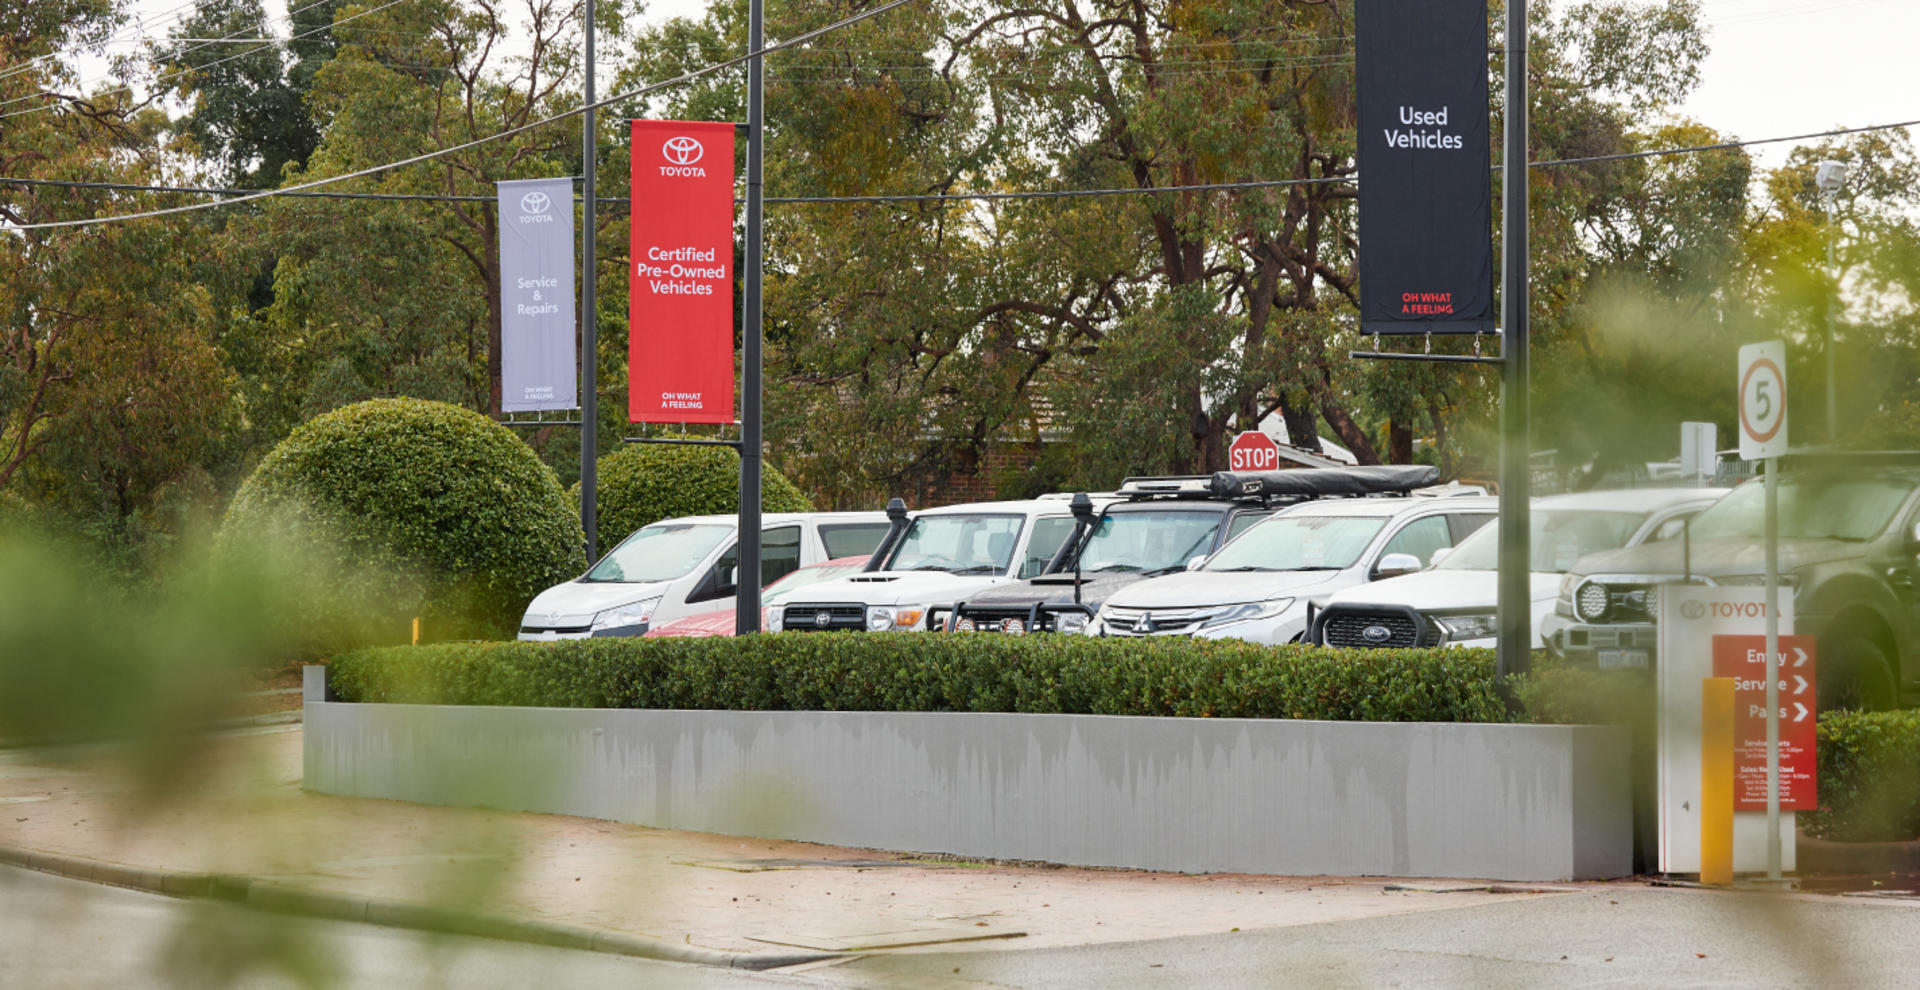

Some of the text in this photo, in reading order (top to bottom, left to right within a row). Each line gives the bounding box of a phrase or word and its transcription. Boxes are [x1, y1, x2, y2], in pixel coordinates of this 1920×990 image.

[1399, 105, 1448, 125] Used
[1383, 128, 1463, 149] Vehicles
[659, 166, 706, 177] TOYOTA
[519, 214, 552, 224] TOYOTA
[648, 246, 715, 262] Certified
[637, 263, 725, 279] Pre-Owned
[517, 275, 558, 290] Service
[649, 279, 713, 295] Vehicles
[532, 289, 543, 302] &
[1402, 292, 1452, 303] OH WHAT
[517, 302, 560, 318] Repairs
[1401, 304, 1454, 315] A FEELING
[662, 392, 703, 401] OH WHAT
[1756, 380, 1771, 421] 5
[661, 400, 703, 409] A FEELING
[1233, 447, 1276, 468] STOP
[1708, 602, 1782, 618] TOYOT
[1746, 648, 1788, 667] Eny
[1734, 676, 1788, 691] Serve
[1748, 704, 1788, 719] Pas
